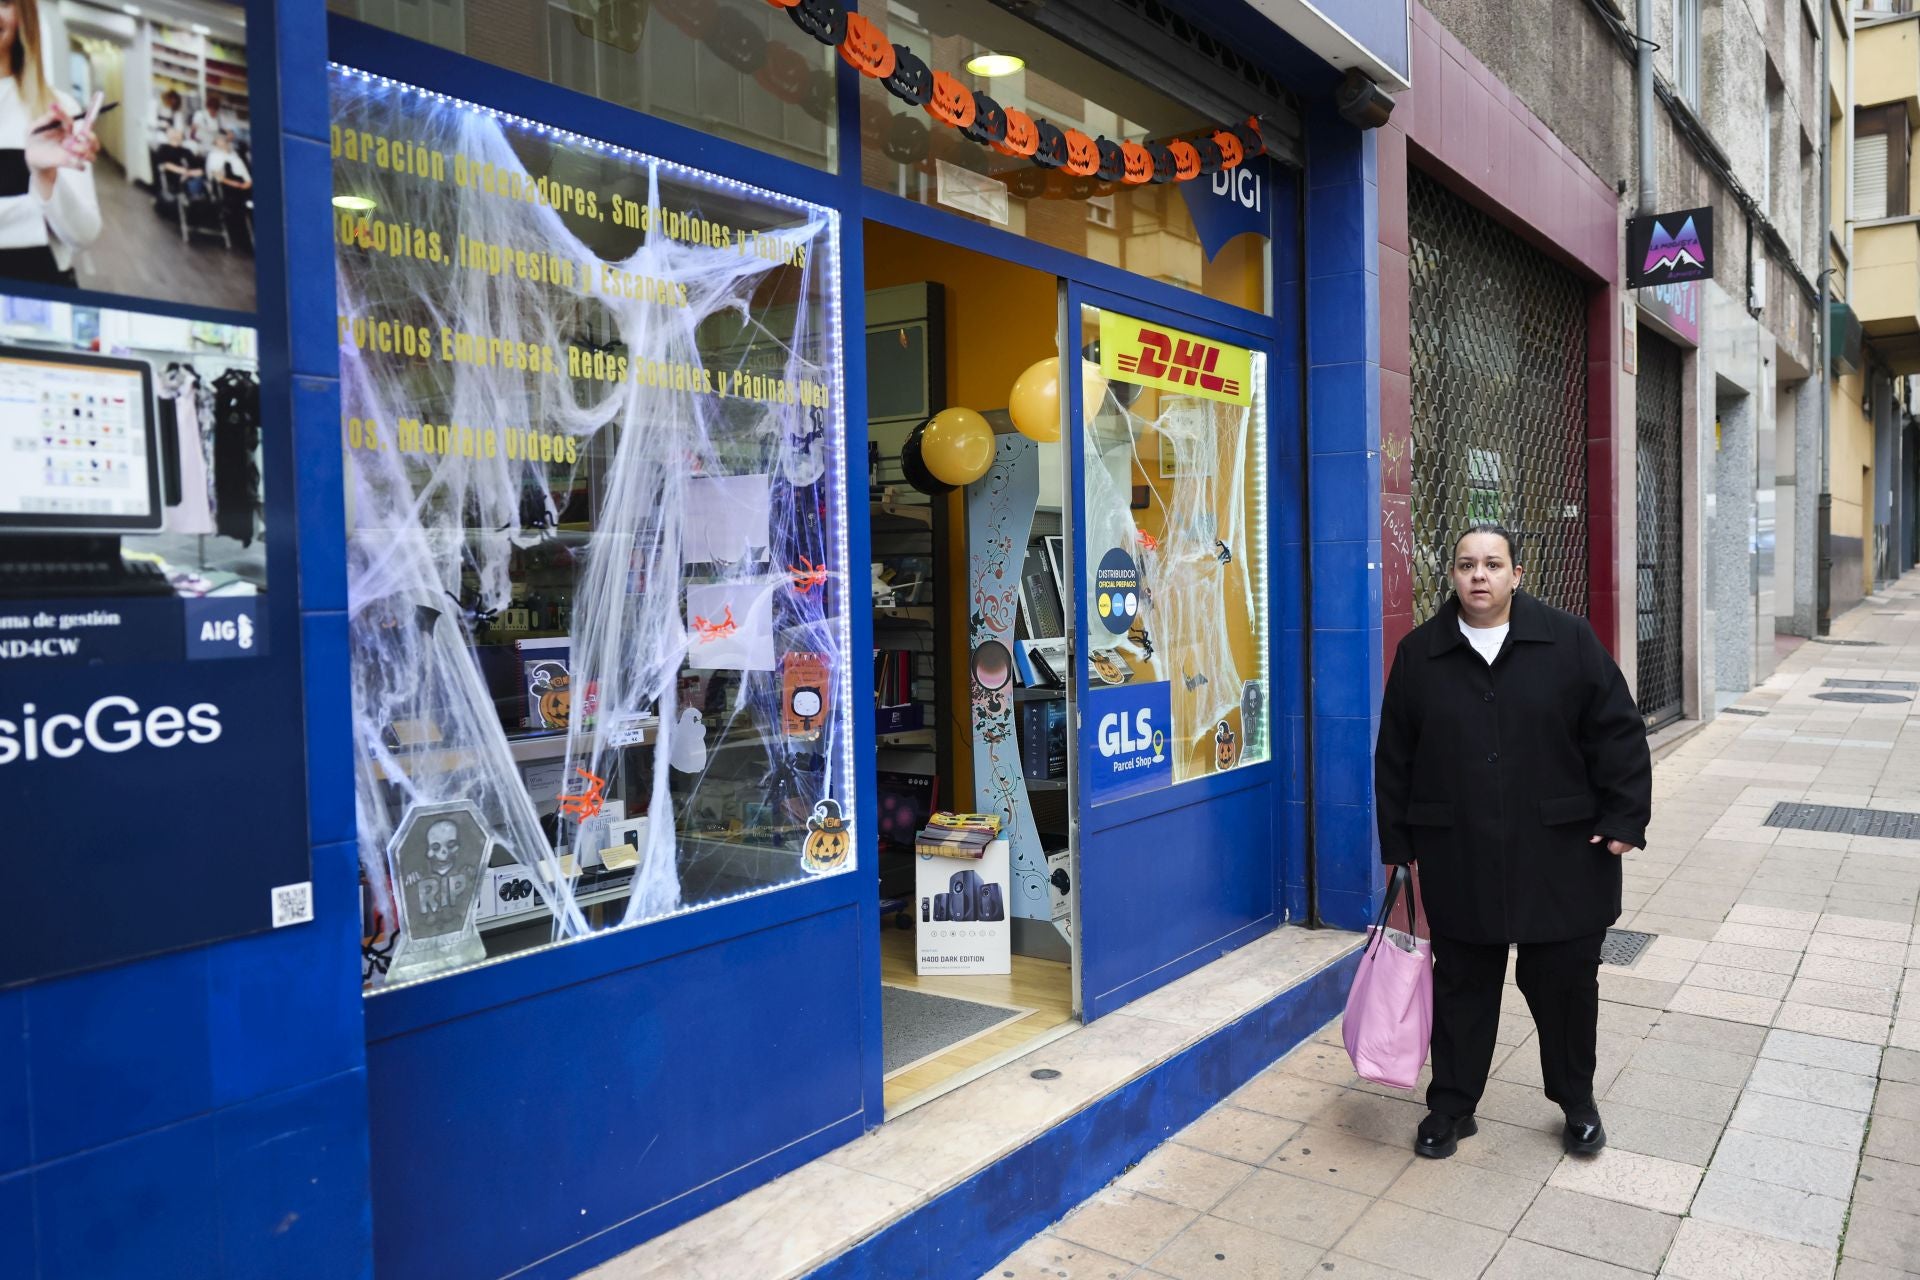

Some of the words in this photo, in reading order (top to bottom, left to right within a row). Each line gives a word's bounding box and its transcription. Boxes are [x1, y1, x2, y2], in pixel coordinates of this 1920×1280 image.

[455, 153, 603, 223] Ordenadores,
[612, 193, 730, 250] Smartphones
[737, 229, 746, 256] y
[752, 230, 806, 269] Tablets
[1213, 166, 1261, 212] DIGI
[335, 211, 449, 266] ocopias,
[568, 345, 628, 383] Redes
[636, 356, 712, 394] Sociales
[718, 371, 727, 398] y
[734, 369, 794, 405] Páginas
[1137, 328, 1225, 392] DHL
[400, 417, 497, 461] Montaje
[1099, 569, 1136, 579] DISTRIBUIDOR
[33, 611, 57, 629] de
[58, 610, 121, 630] gestión
[200, 621, 236, 641] AIG
[0, 695, 222, 765] sicGes
[1098, 707, 1153, 758] GLS
[1113, 758, 1135, 773] Parcel
[1136, 756, 1152, 769] Shop
[418, 875, 467, 913] RIP
[921, 955, 939, 963] H400
[940, 955, 958, 963] DARK
[959, 955, 985, 963] EDITION
